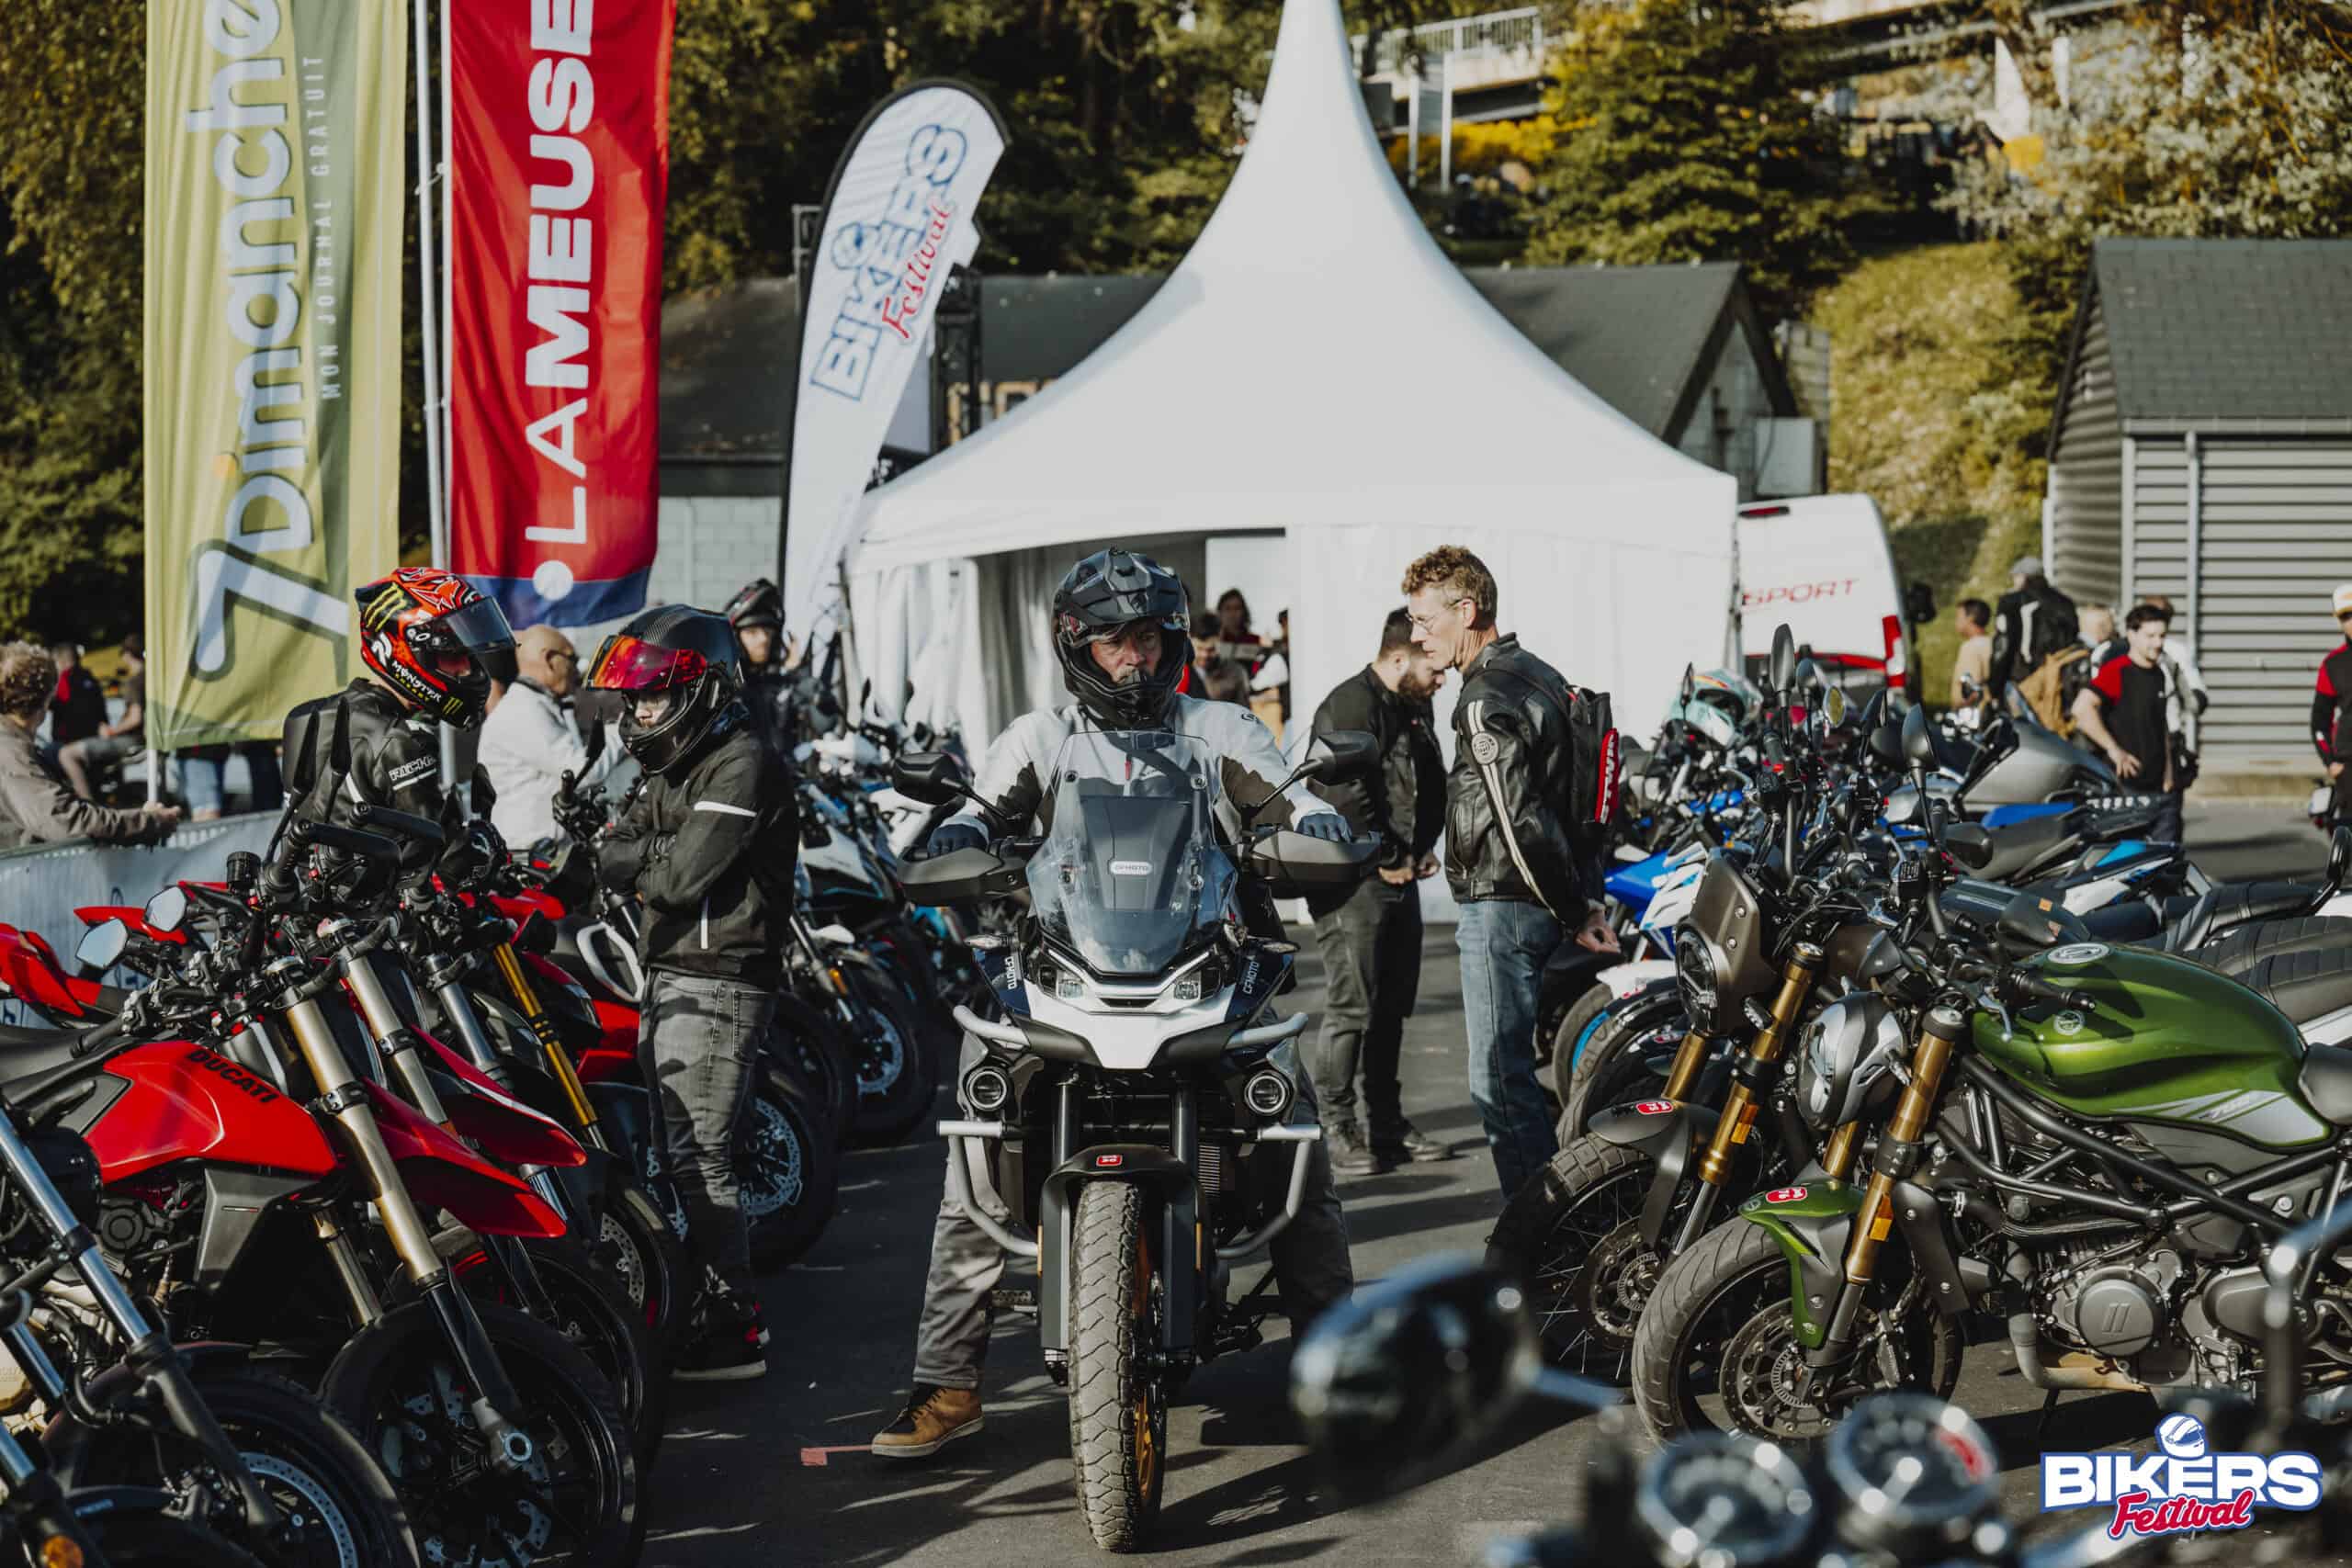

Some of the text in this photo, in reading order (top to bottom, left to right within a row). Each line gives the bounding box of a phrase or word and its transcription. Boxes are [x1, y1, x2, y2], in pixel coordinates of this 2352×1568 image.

[301, 56, 342, 400] MON JOURNAL GRATUIT
[809, 124, 967, 401] BIKERS
[881, 203, 952, 340] Festival
[391, 659, 443, 704] MONSTER
[1242, 960, 1260, 994] CFMOTO
[186, 1049, 279, 1103] DUCATI
